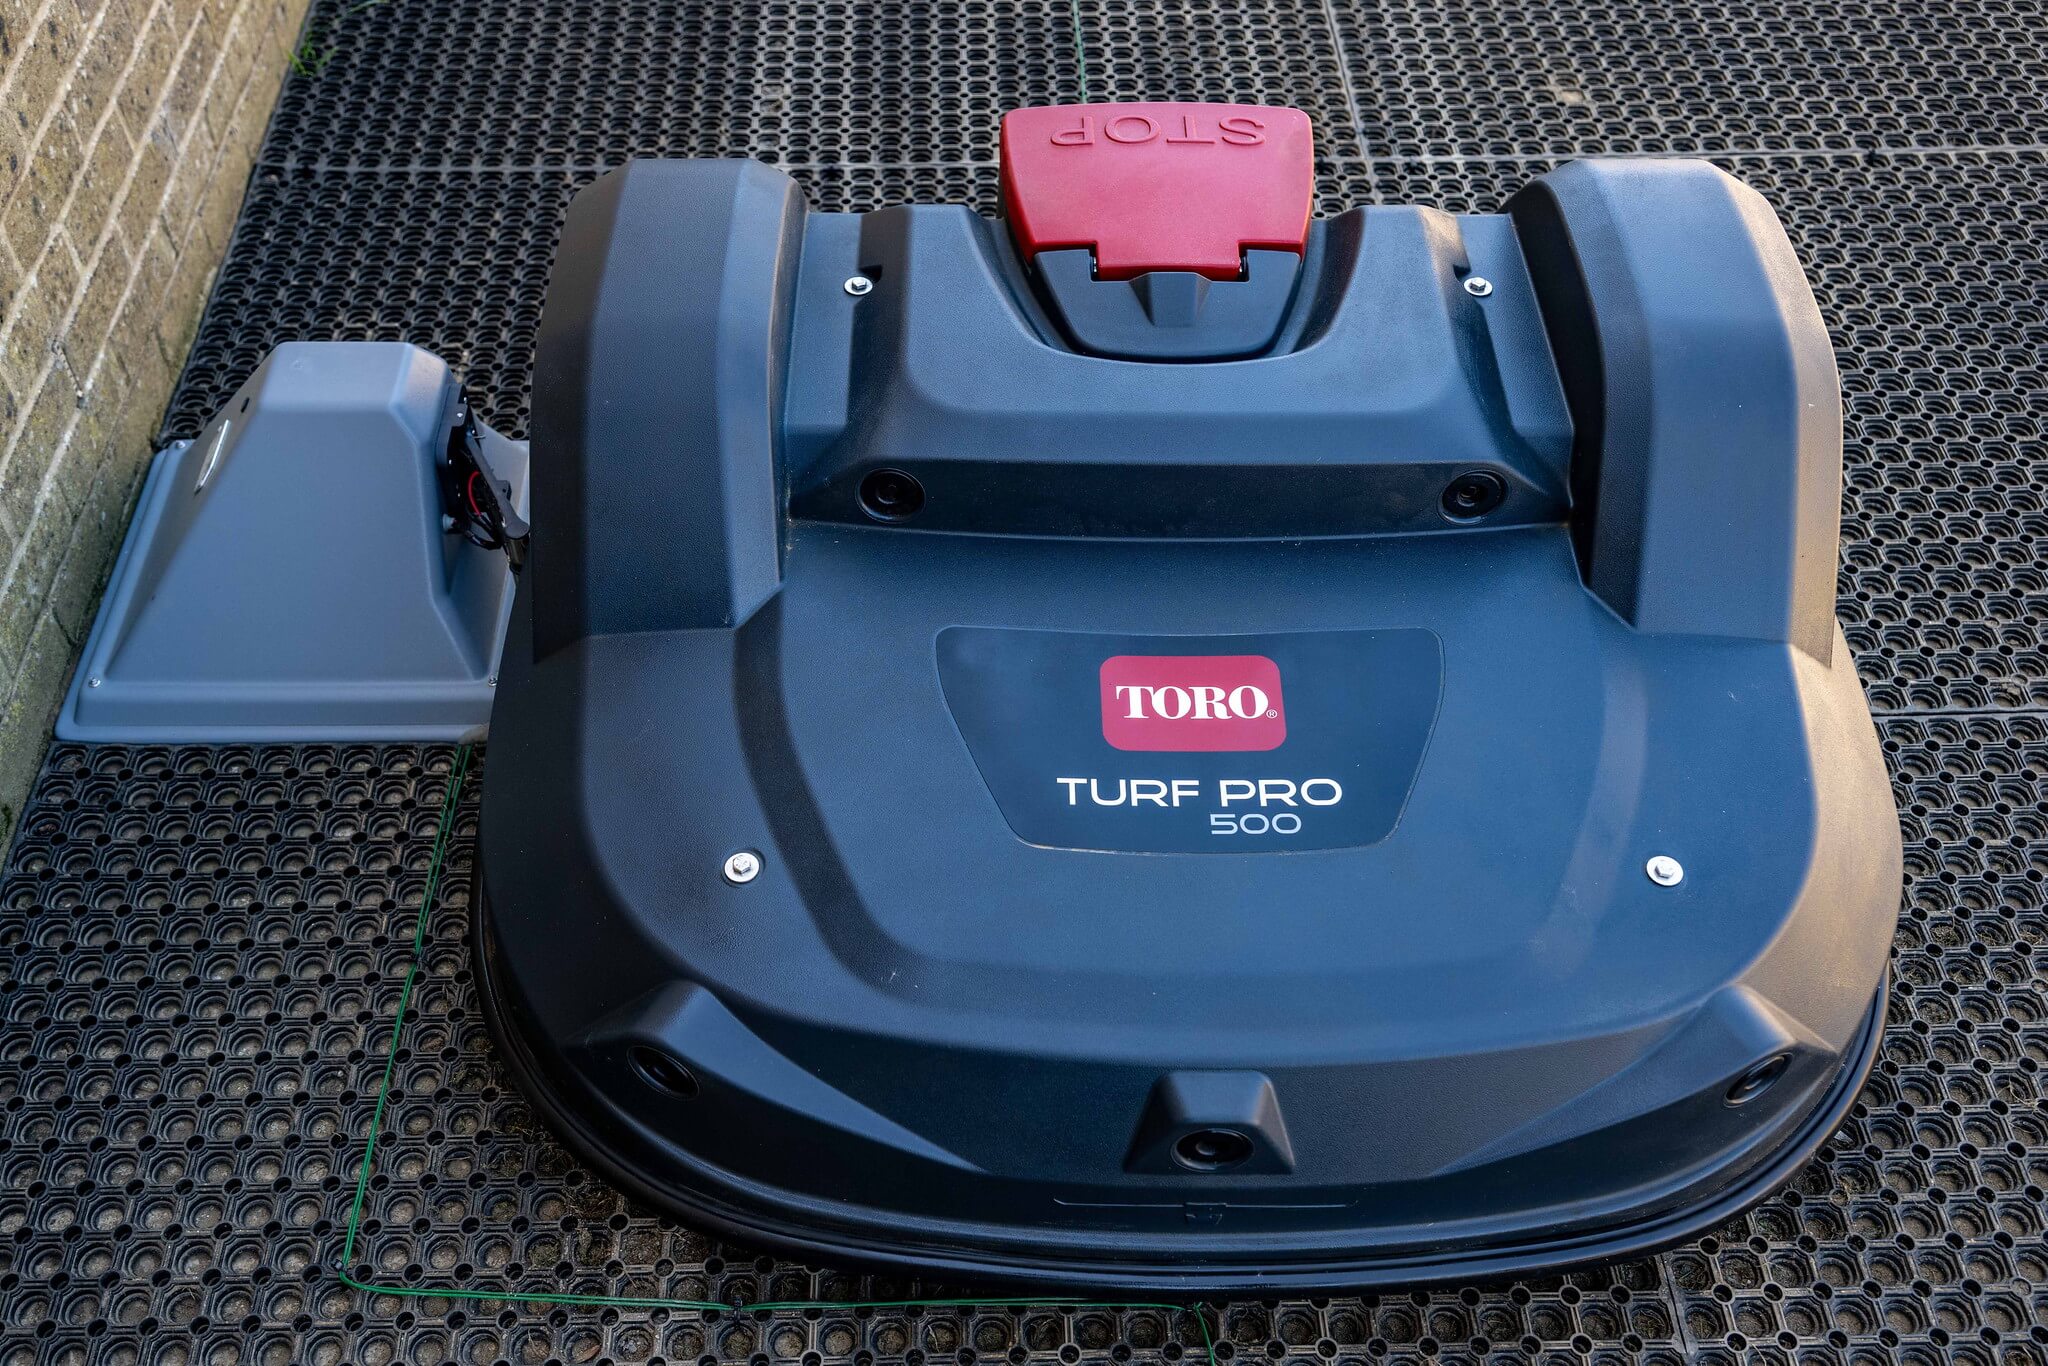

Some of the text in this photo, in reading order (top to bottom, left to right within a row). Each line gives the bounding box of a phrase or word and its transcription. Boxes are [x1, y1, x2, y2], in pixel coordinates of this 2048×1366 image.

[1056, 777, 1343, 807] TURF PRO
[1210, 813, 1301, 835] 500
